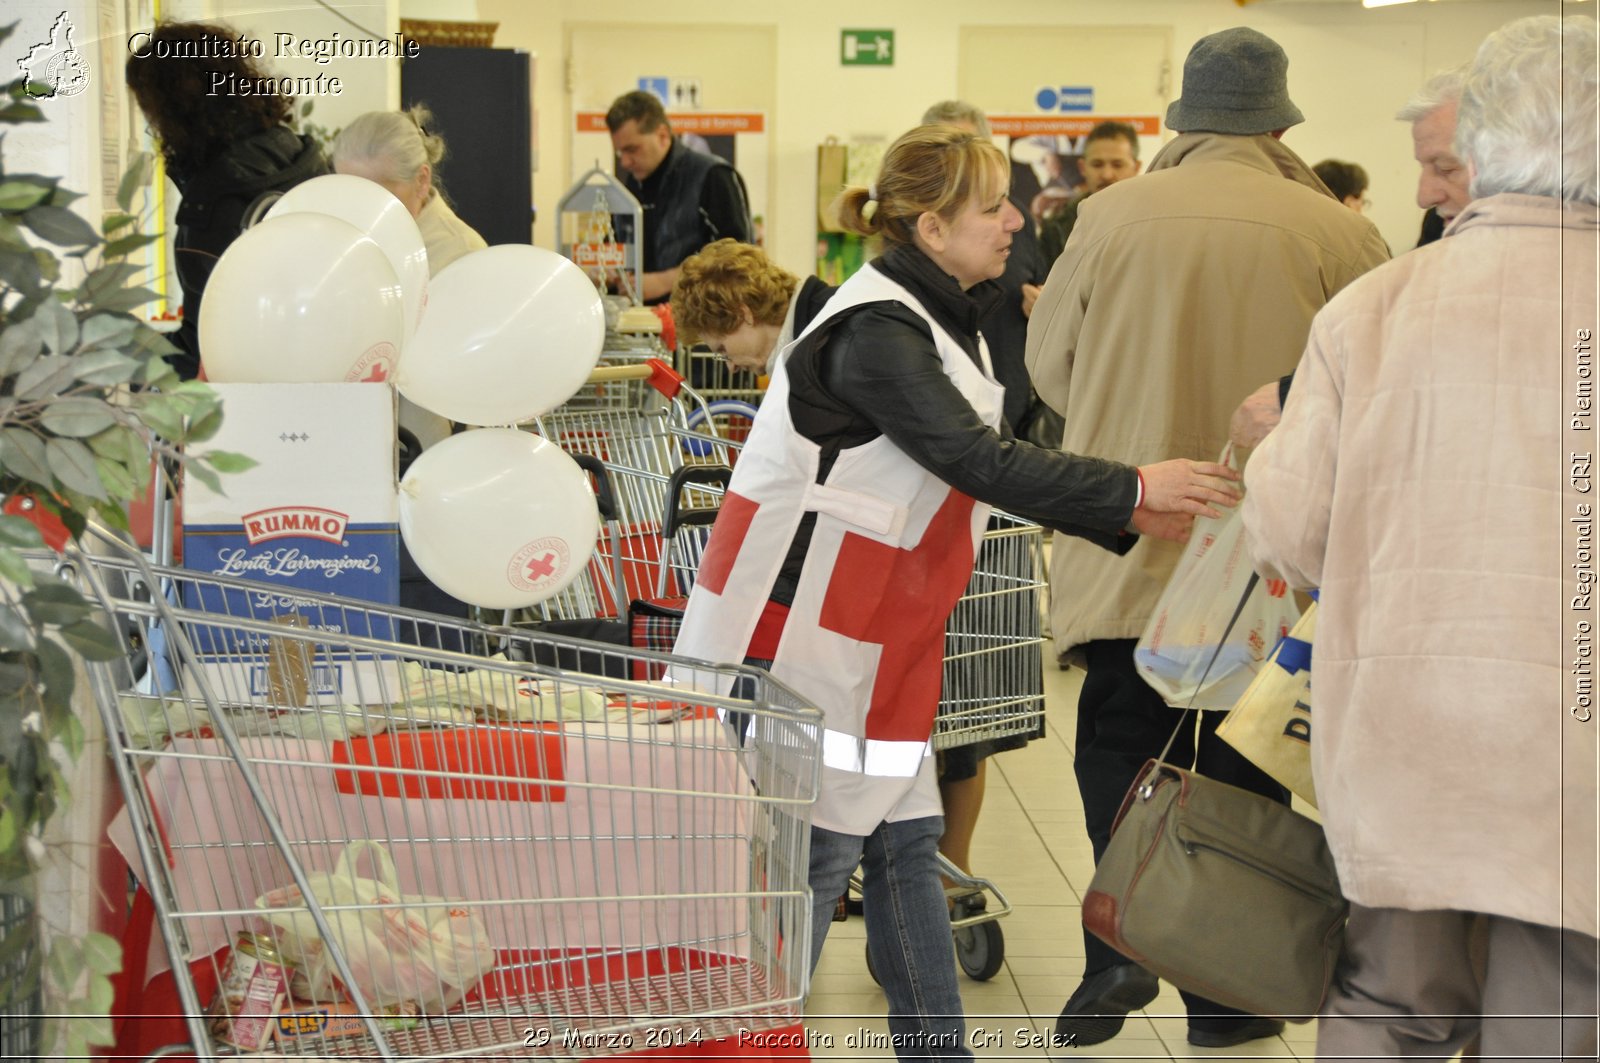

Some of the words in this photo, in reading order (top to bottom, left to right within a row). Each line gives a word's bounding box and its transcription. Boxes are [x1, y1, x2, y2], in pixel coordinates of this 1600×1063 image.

[249, 513, 340, 537] RUMMO
[212, 548, 273, 577] Lenta
[265, 548, 379, 578] Lavorazione
